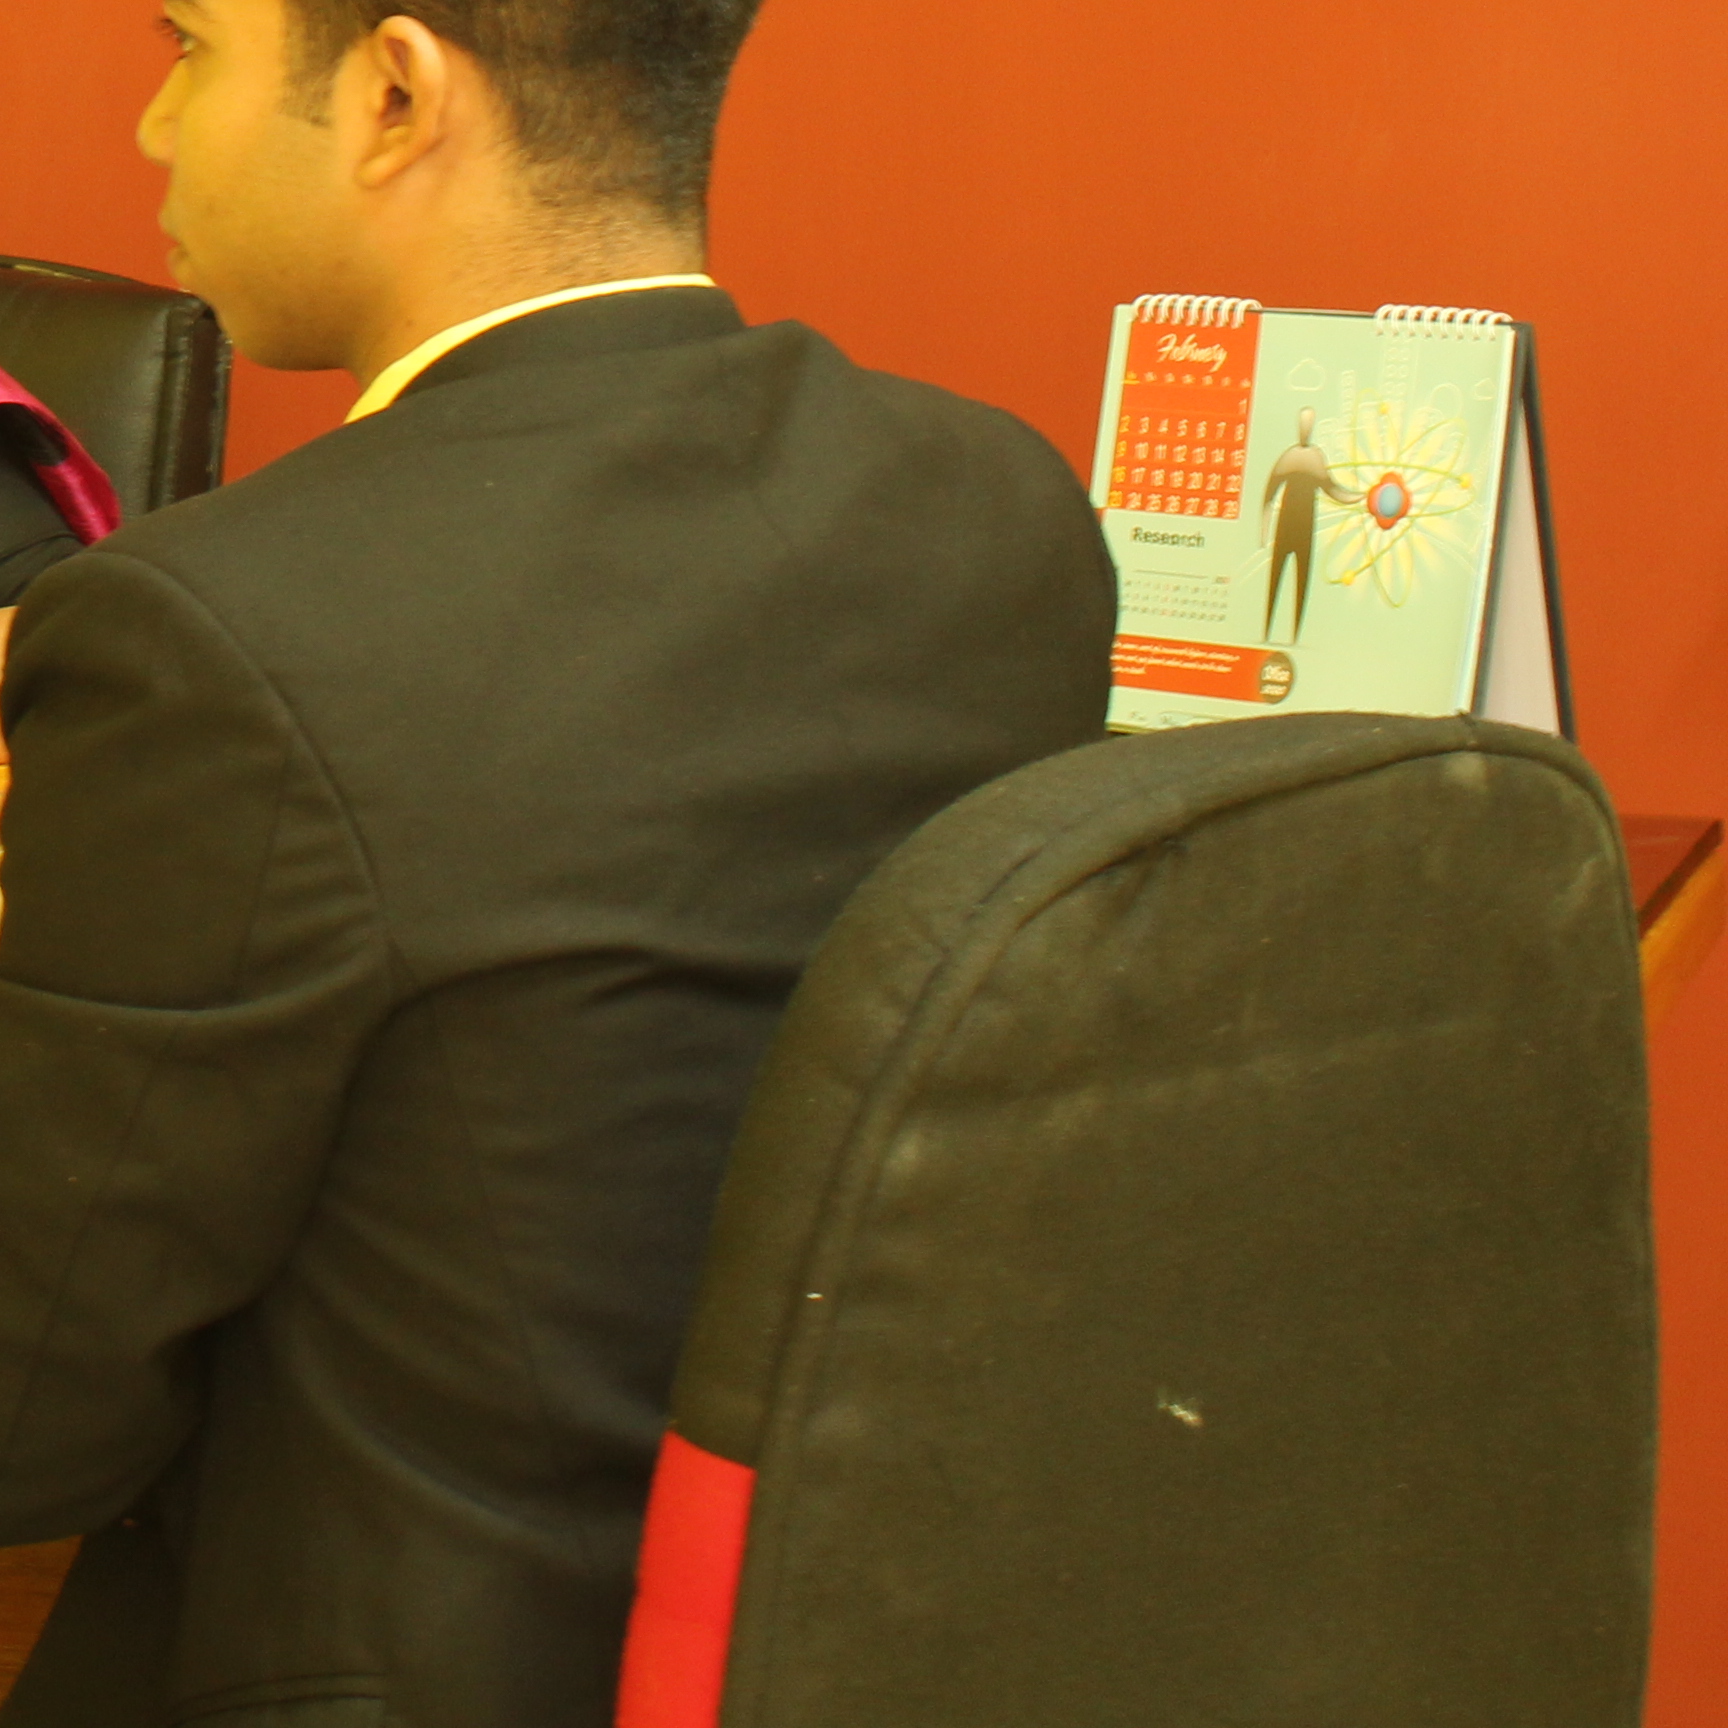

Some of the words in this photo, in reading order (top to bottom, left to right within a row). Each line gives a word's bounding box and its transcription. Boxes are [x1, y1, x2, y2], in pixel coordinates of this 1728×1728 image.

[1156, 333, 1228, 373] February
[1238, 398, 1247, 415] 1
[1119, 415, 1130, 433] 2
[1139, 416, 1149, 434] 3
[1158, 418, 1169, 434] 4
[1177, 419, 1189, 437] 5
[1196, 421, 1207, 439] 6
[1216, 421, 1227, 440] 7
[1234, 423, 1245, 442] 8
[1134, 442, 1149, 460] 10
[1154, 444, 1167, 461] 11
[1173, 445, 1188, 463] 12
[1192, 446, 1207, 464] 13
[1211, 448, 1225, 464] 14
[1230, 449, 1245, 467] 15
[1131, 467, 1147, 485] 17
[1150, 469, 1165, 487] 18
[1169, 470, 1184, 488] 19
[1186, 471, 1204, 490] 20
[1205, 473, 1222, 491] 21
[1225, 474, 1242, 493] 22
[1126, 492, 1142, 510] 24
[1145, 493, 1162, 512] 25
[1164, 495, 1181, 513] 26
[1183, 497, 1201, 515] 27
[1203, 498, 1219, 517] 28
[1222, 500, 1239, 518] 29
[1132, 526, 1205, 547] Research
